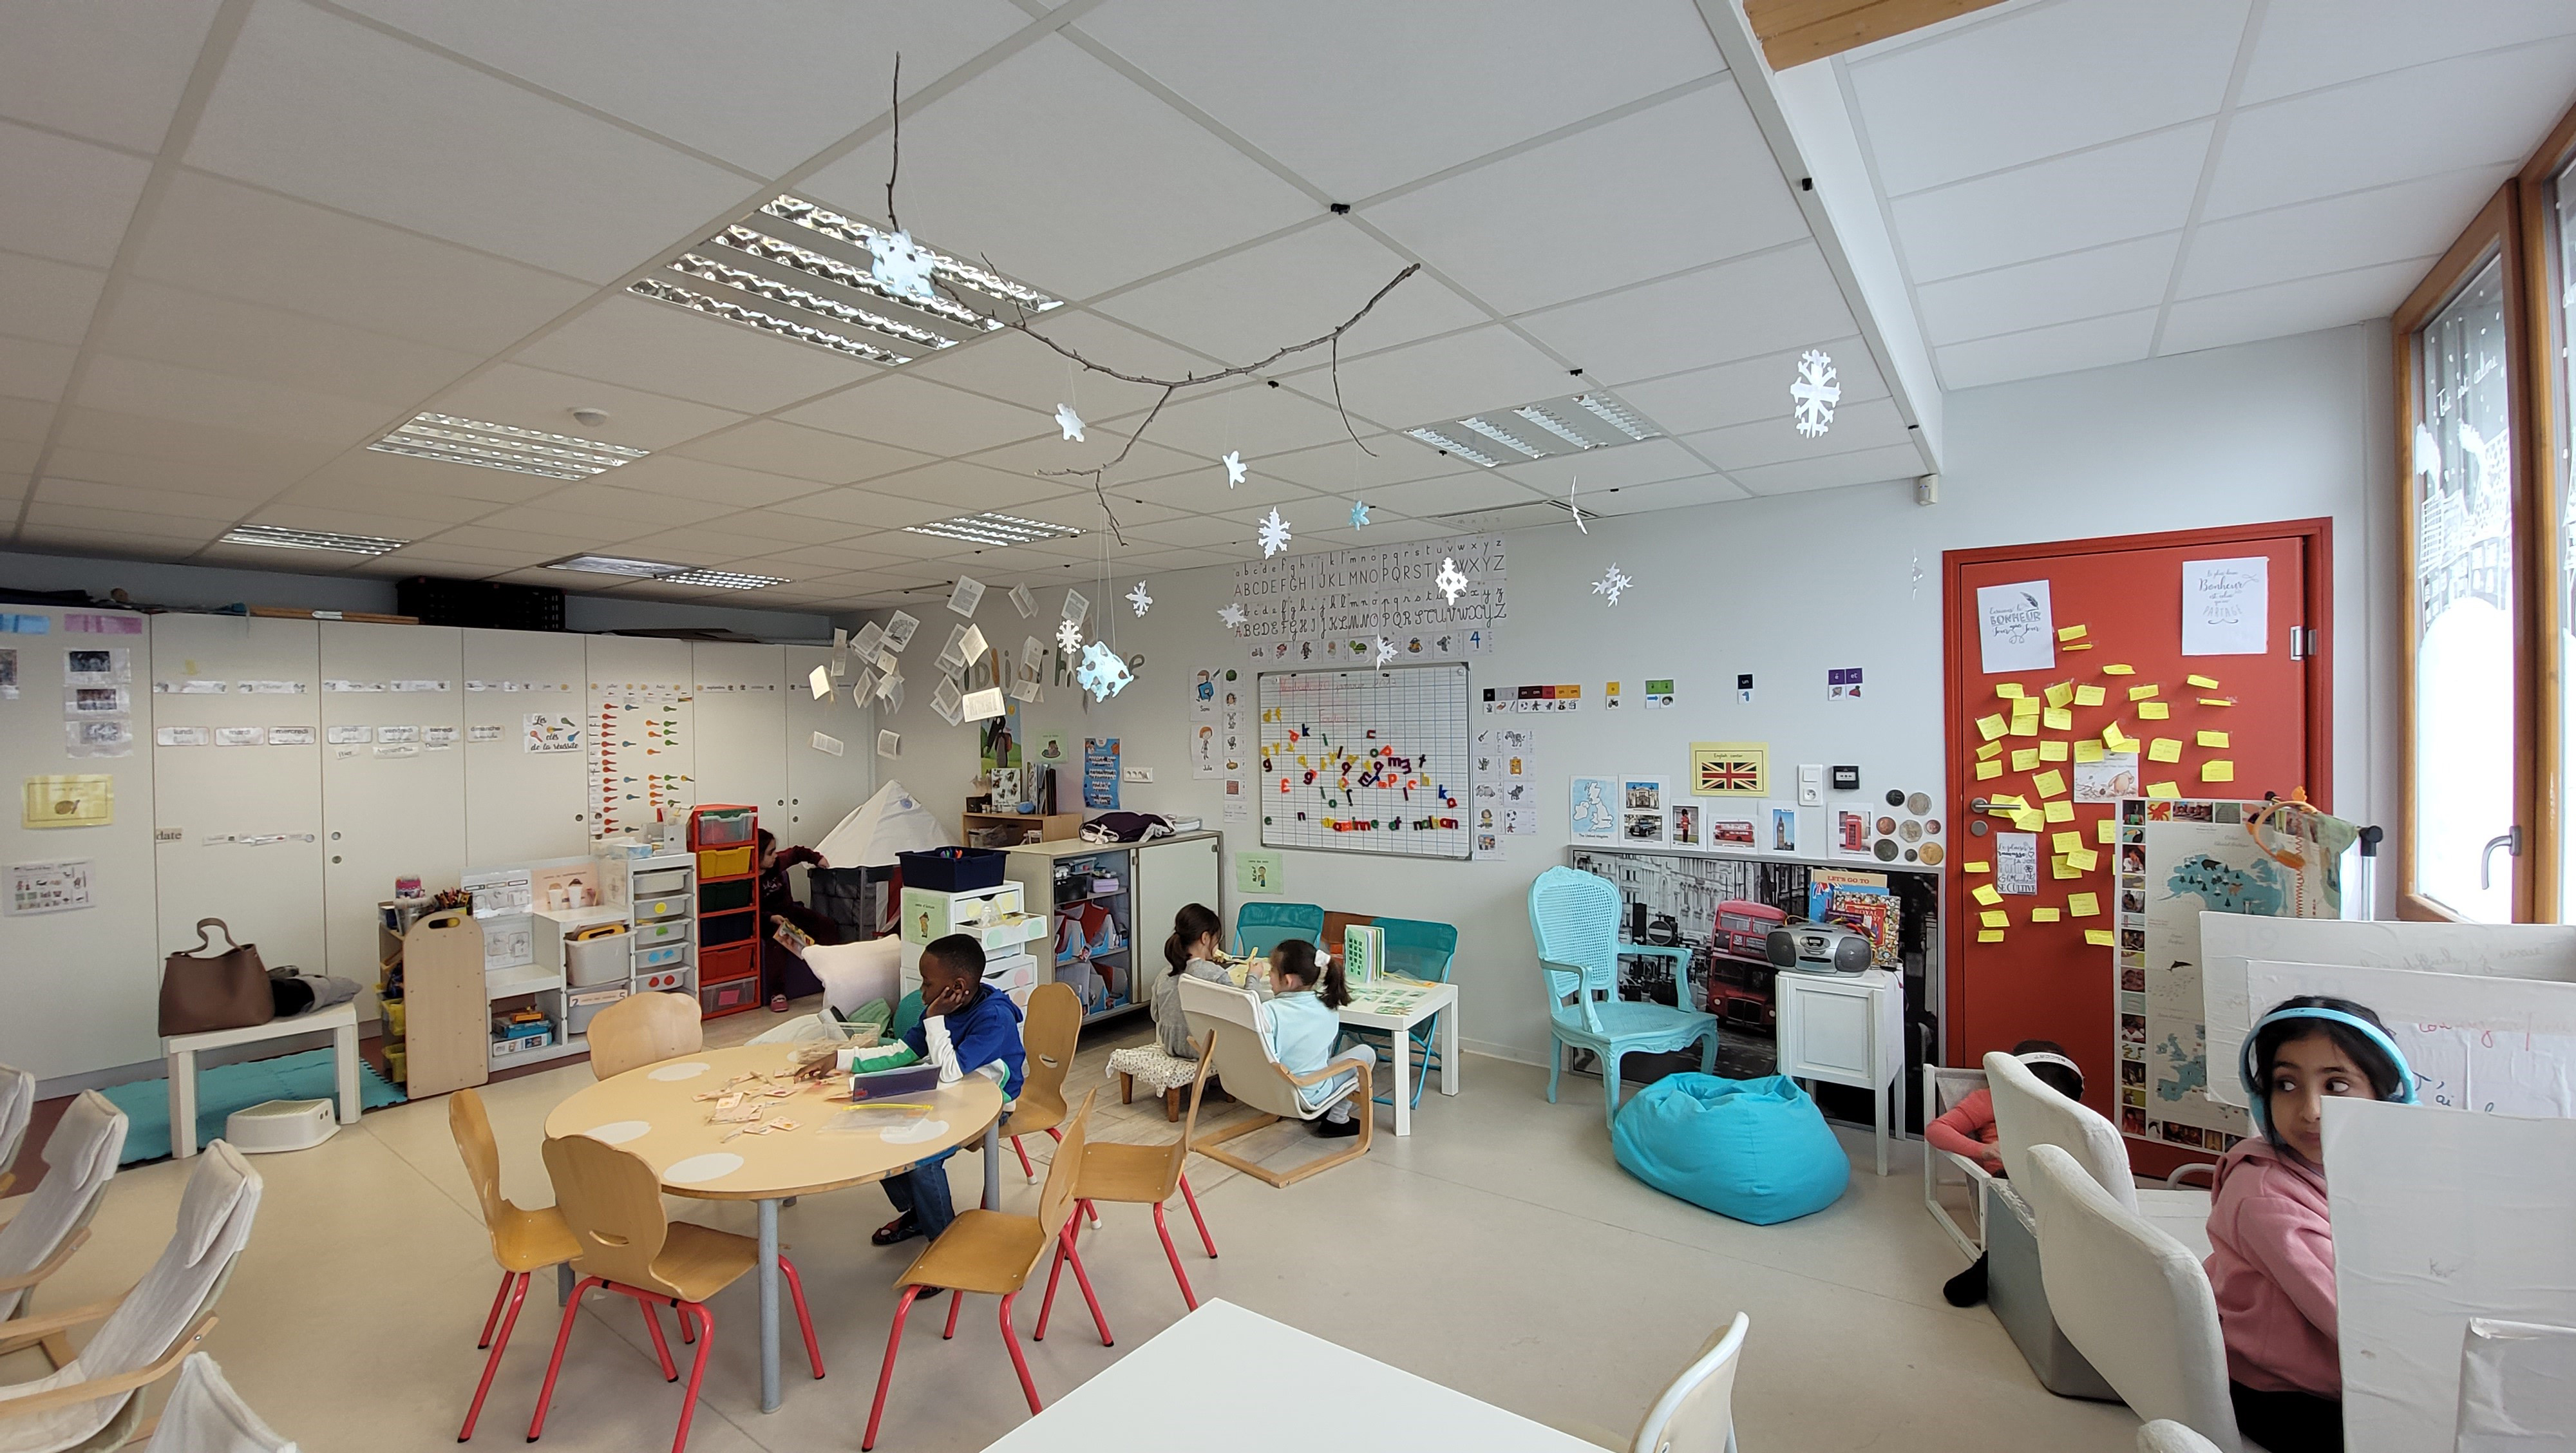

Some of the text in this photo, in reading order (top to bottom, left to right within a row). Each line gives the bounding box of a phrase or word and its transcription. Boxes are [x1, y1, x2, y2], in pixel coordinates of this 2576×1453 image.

[2199, 576, 2242, 591] Bonheur
[1990, 611, 2041, 625] BONHEUR
[2202, 605, 2242, 617] PARTAGE
[1470, 631, 1481, 649] 4
[533, 716, 547, 726] Les
[1302, 723, 1311, 737] k
[156, 830, 182, 840] date
